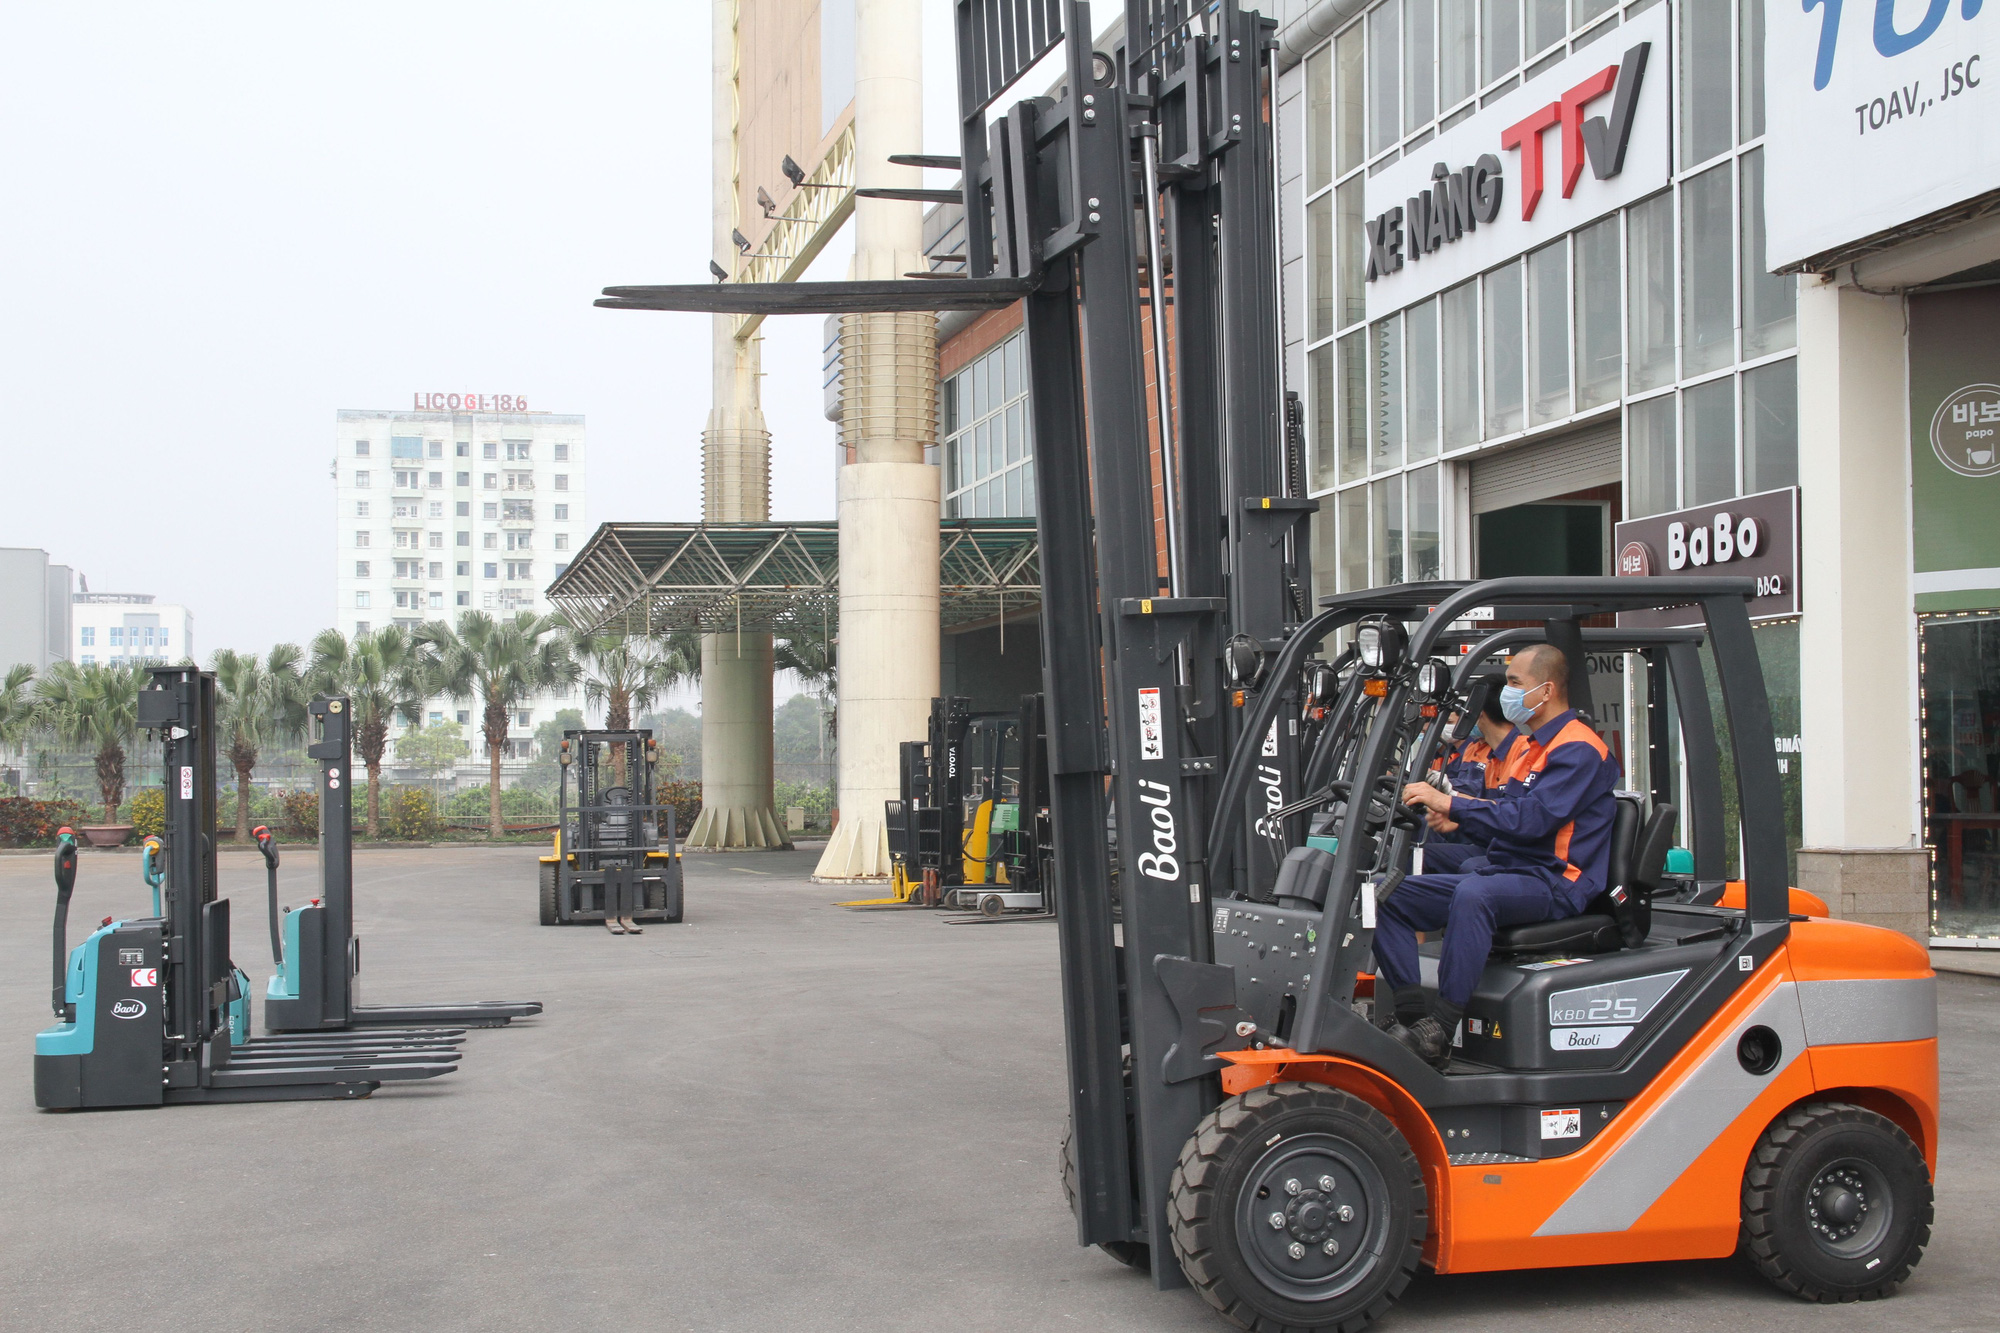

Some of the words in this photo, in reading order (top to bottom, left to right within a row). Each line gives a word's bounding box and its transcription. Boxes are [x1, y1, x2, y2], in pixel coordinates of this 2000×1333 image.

[1940, 54, 1981, 101] JSC
[1365, 206, 1403, 282] XE
[1407, 153, 1503, 261] NÂNG
[414, 392, 528, 412] LICOGI-18.6
[1965, 428, 1994, 441] papo
[1667, 511, 1759, 571] BaBo
[1622, 554, 1642, 575] 바보
[1756, 574, 1782, 597] BBQ
[948, 746, 956, 779] TOYOTA
[1137, 778, 1181, 882] Baoli
[113, 1001, 140, 1015] Baoli
[1553, 1009, 1586, 1021] KBD
[1588, 997, 1638, 1020] 25
[1567, 1030, 1601, 1047] Baoli
